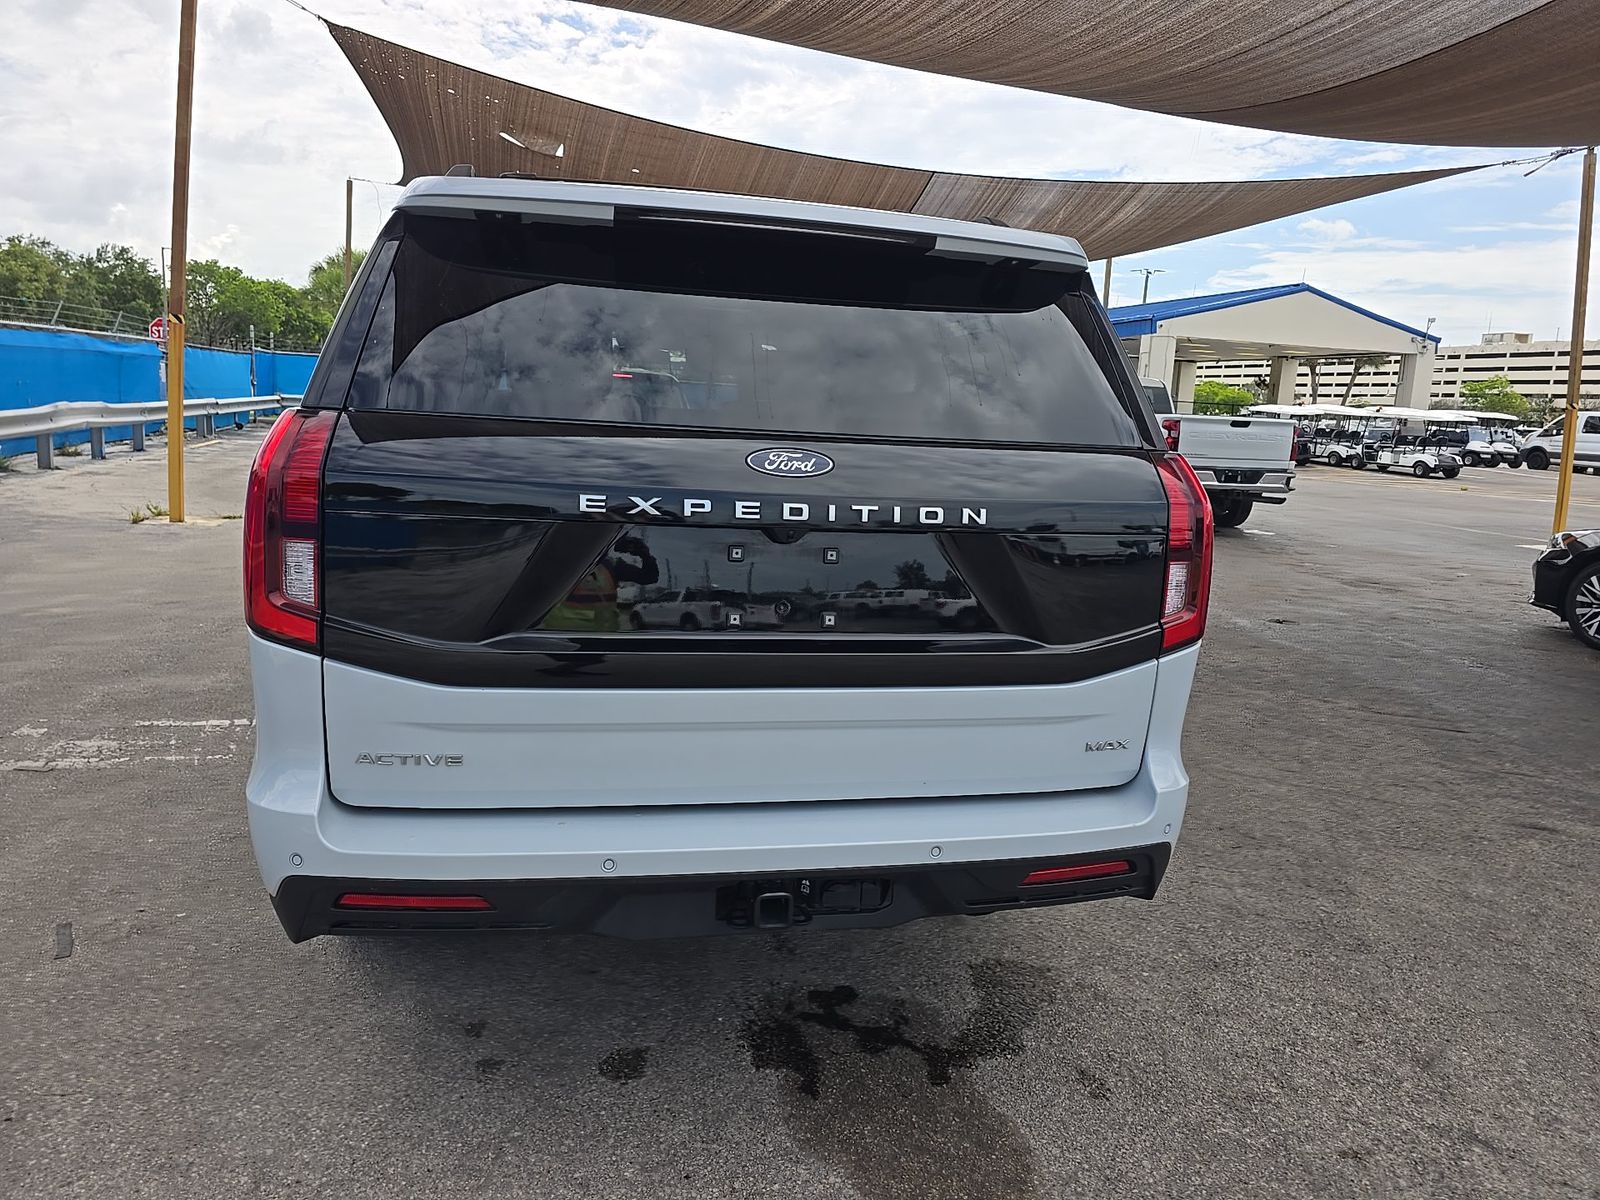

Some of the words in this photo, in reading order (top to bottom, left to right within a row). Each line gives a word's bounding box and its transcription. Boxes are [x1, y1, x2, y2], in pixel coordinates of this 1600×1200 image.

[152, 326, 169, 338] ST
[764, 452, 816, 472] Ford
[578, 493, 988, 526] EXPEDITION
[1085, 739, 1129, 752] MAX
[355, 751, 464, 767] ACTIVE
